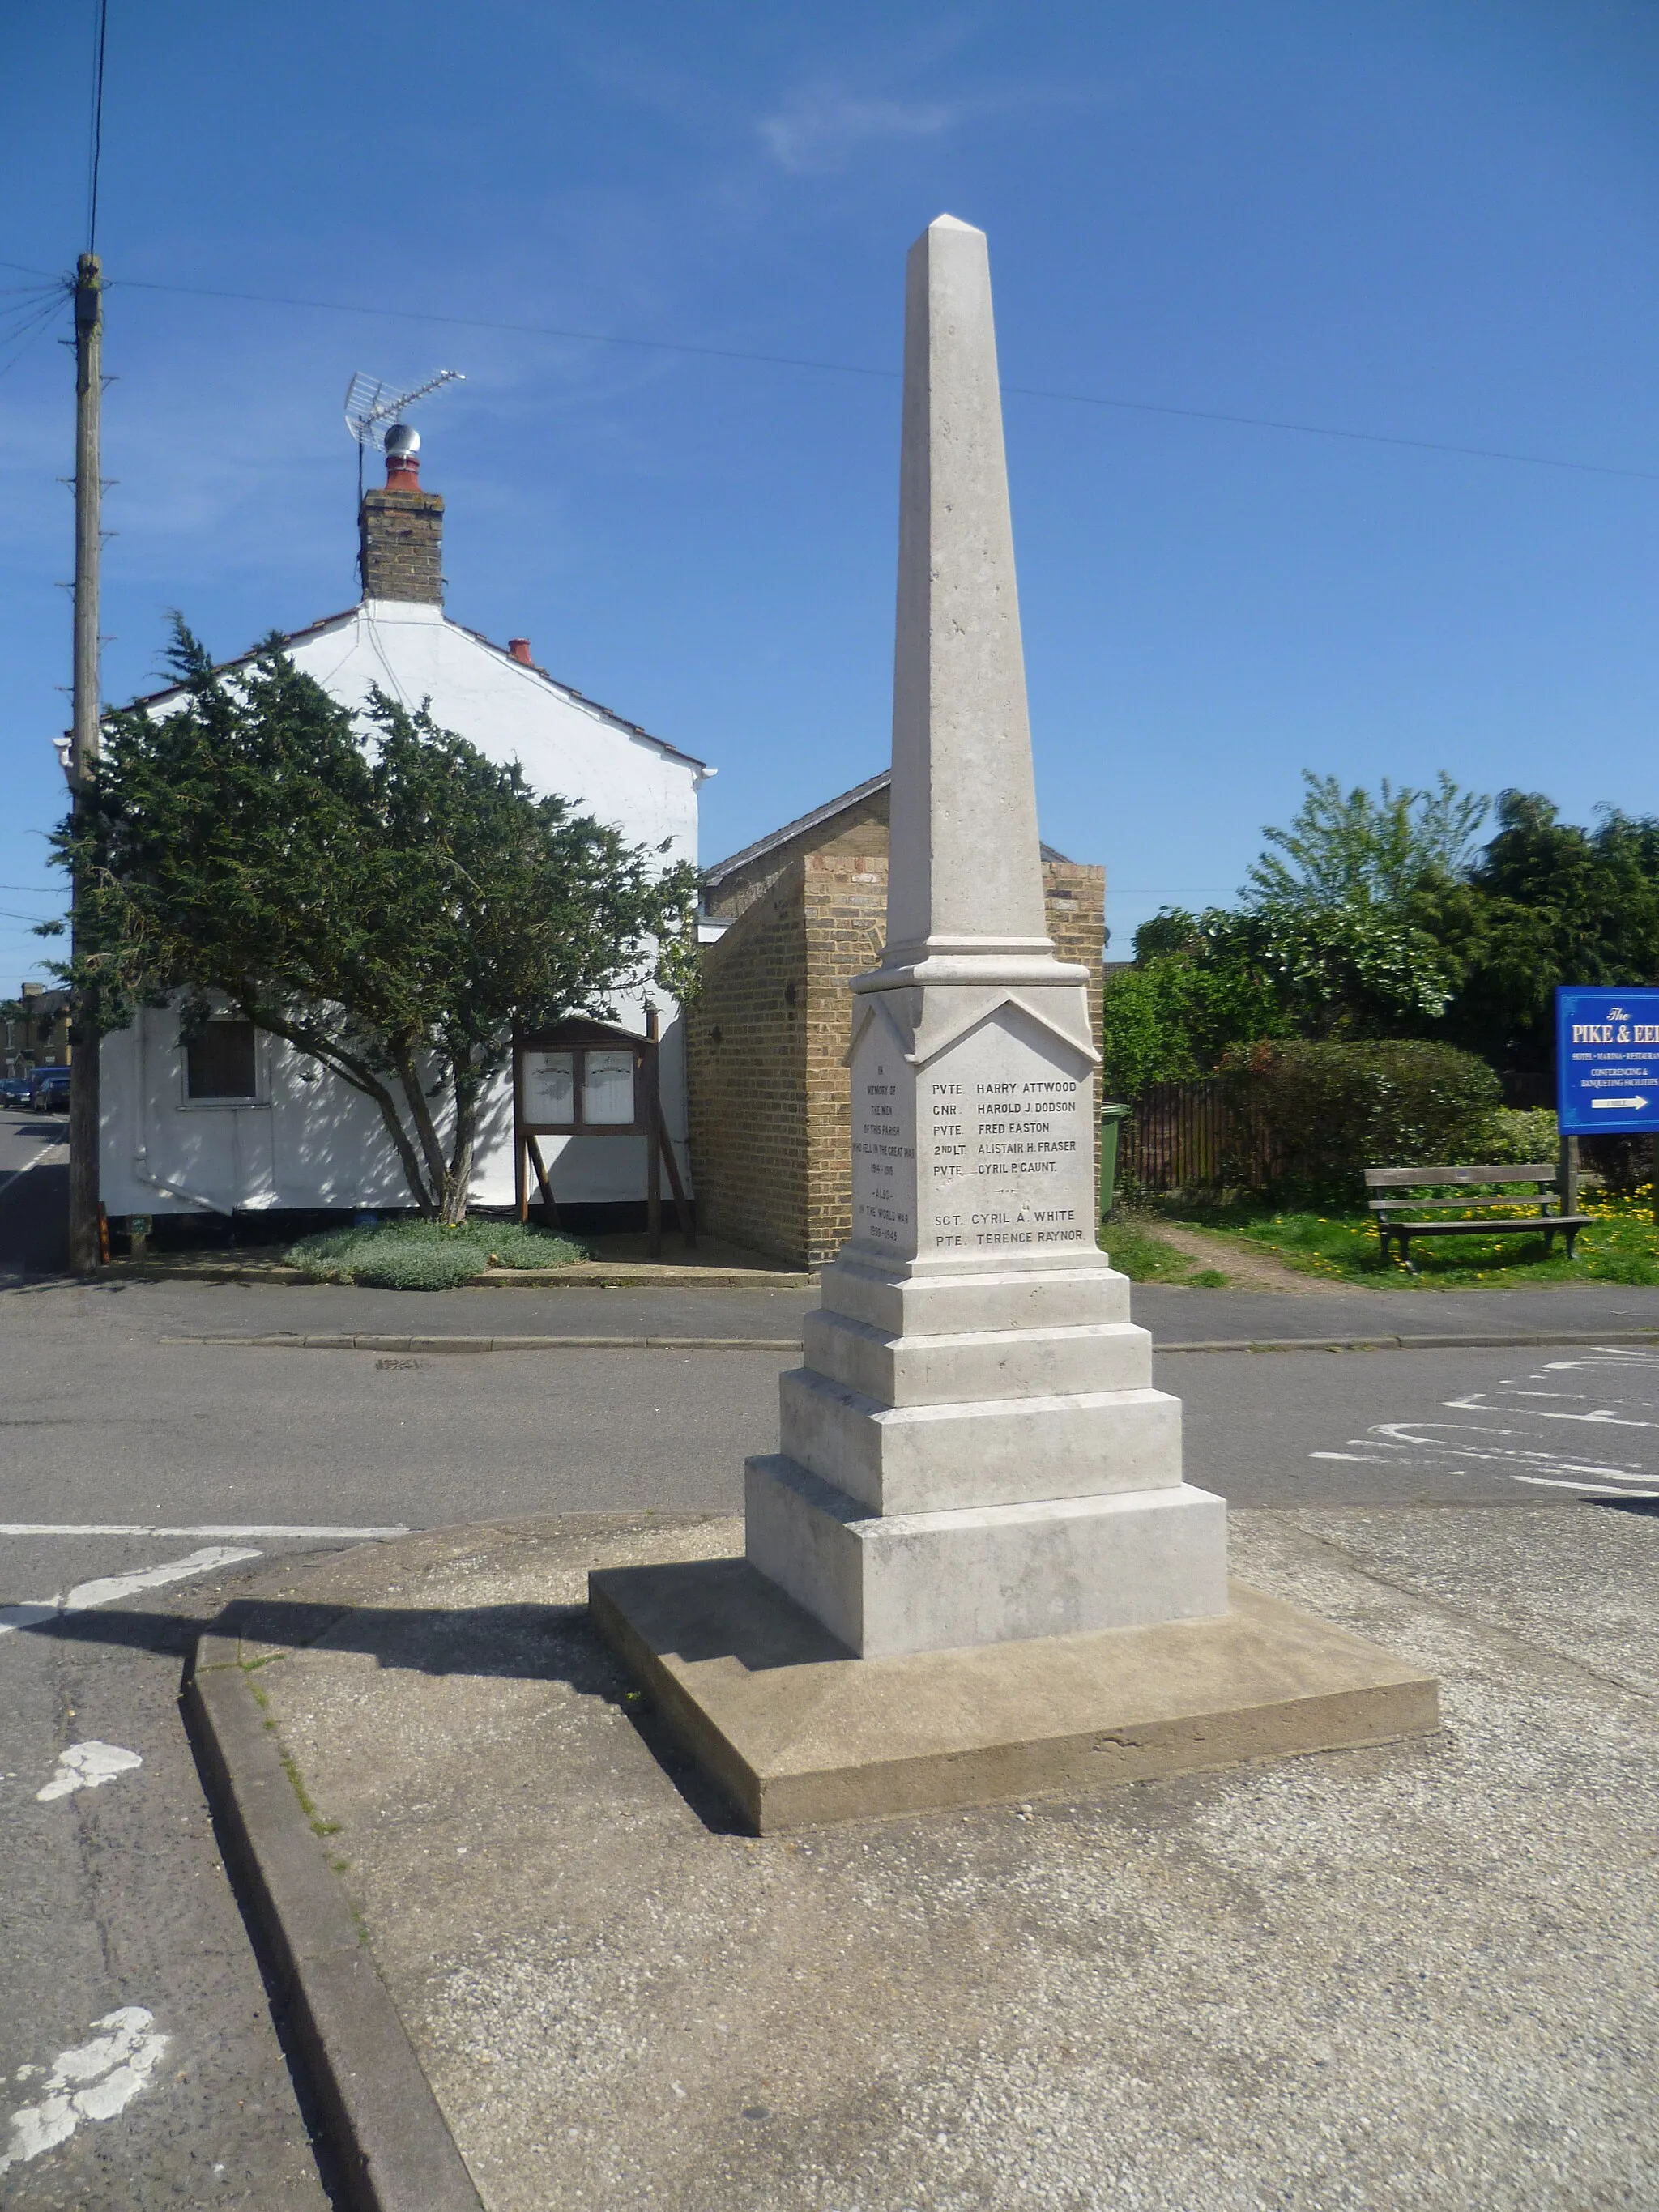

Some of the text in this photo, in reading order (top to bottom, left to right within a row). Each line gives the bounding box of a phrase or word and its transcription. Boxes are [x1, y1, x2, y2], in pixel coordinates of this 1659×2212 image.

[1606, 1008, 1631, 1021] The
[1572, 1025, 1613, 1043] PIKE
[1617, 1025, 1631, 1043] &
[1572, 1052, 1593, 1060] HOTEL
[1597, 1052, 1623, 1060] MARINA
[1590, 1068, 1642, 1076] CONFERENCING
[977, 1083, 1017, 1093] HARRY
[1022, 1081, 1077, 1093] ATTWOOD
[1580, 1078, 1658, 1089] BANQUETING FACILITIES
[867, 1085, 896, 1096] MEMORY OF
[871, 1105, 893, 1116] THE MEN
[978, 1103, 1021, 1115] HAROLD
[1035, 1102, 1076, 1112] DODSON
[882, 1124, 900, 1136] PARISH
[979, 1123, 1005, 1135] FRED
[1009, 1122, 1050, 1133] EASTON
[978, 1143, 1024, 1154] ALISTAIR
[1038, 1141, 1077, 1153] FRASER
[978, 1163, 1009, 1174] CYRIL
[877, 1208, 895, 1221] WORLD
[971, 1213, 1010, 1225] CYRIL
[1034, 1209, 1075, 1222] WHITE
[977, 1231, 1032, 1245] TERENCE
